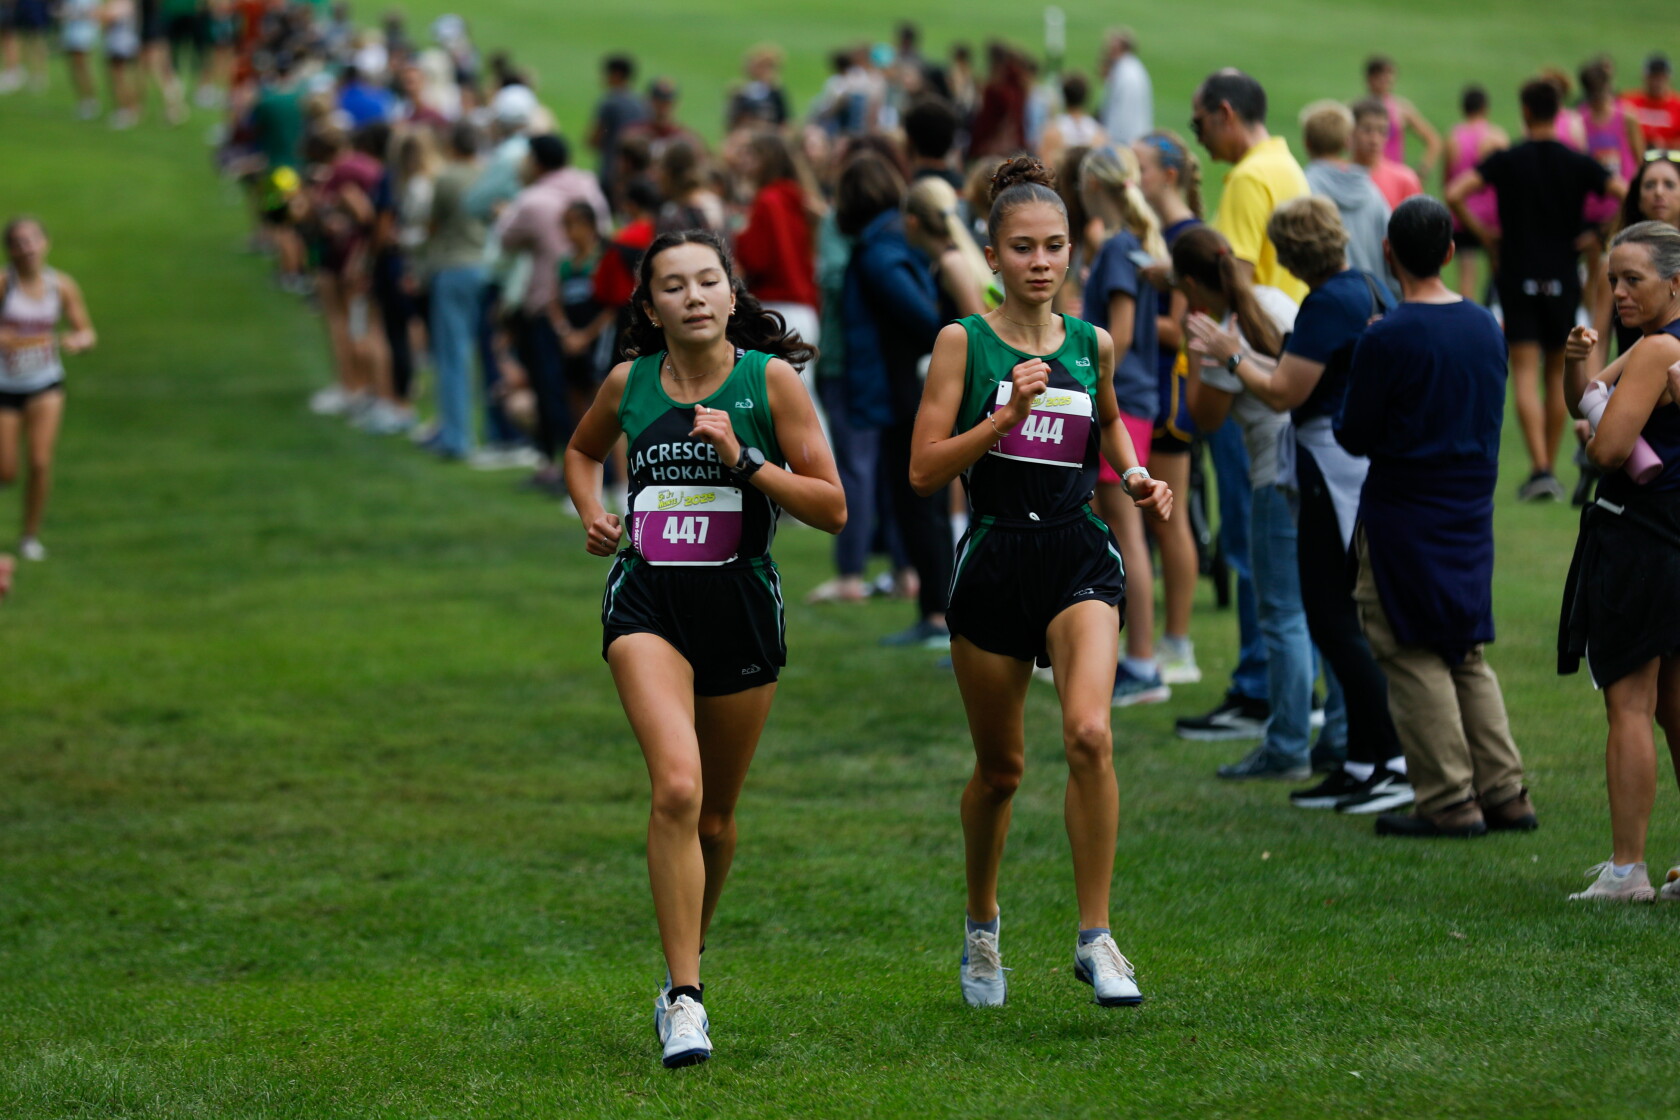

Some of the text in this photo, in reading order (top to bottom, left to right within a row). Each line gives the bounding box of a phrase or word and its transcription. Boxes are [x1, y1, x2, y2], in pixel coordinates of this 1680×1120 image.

[1020, 414, 1064, 445] 444
[630, 450, 646, 476] LA
[651, 465, 721, 481] HOKAH
[684, 492, 716, 507] 2025
[662, 516, 710, 544] 447
